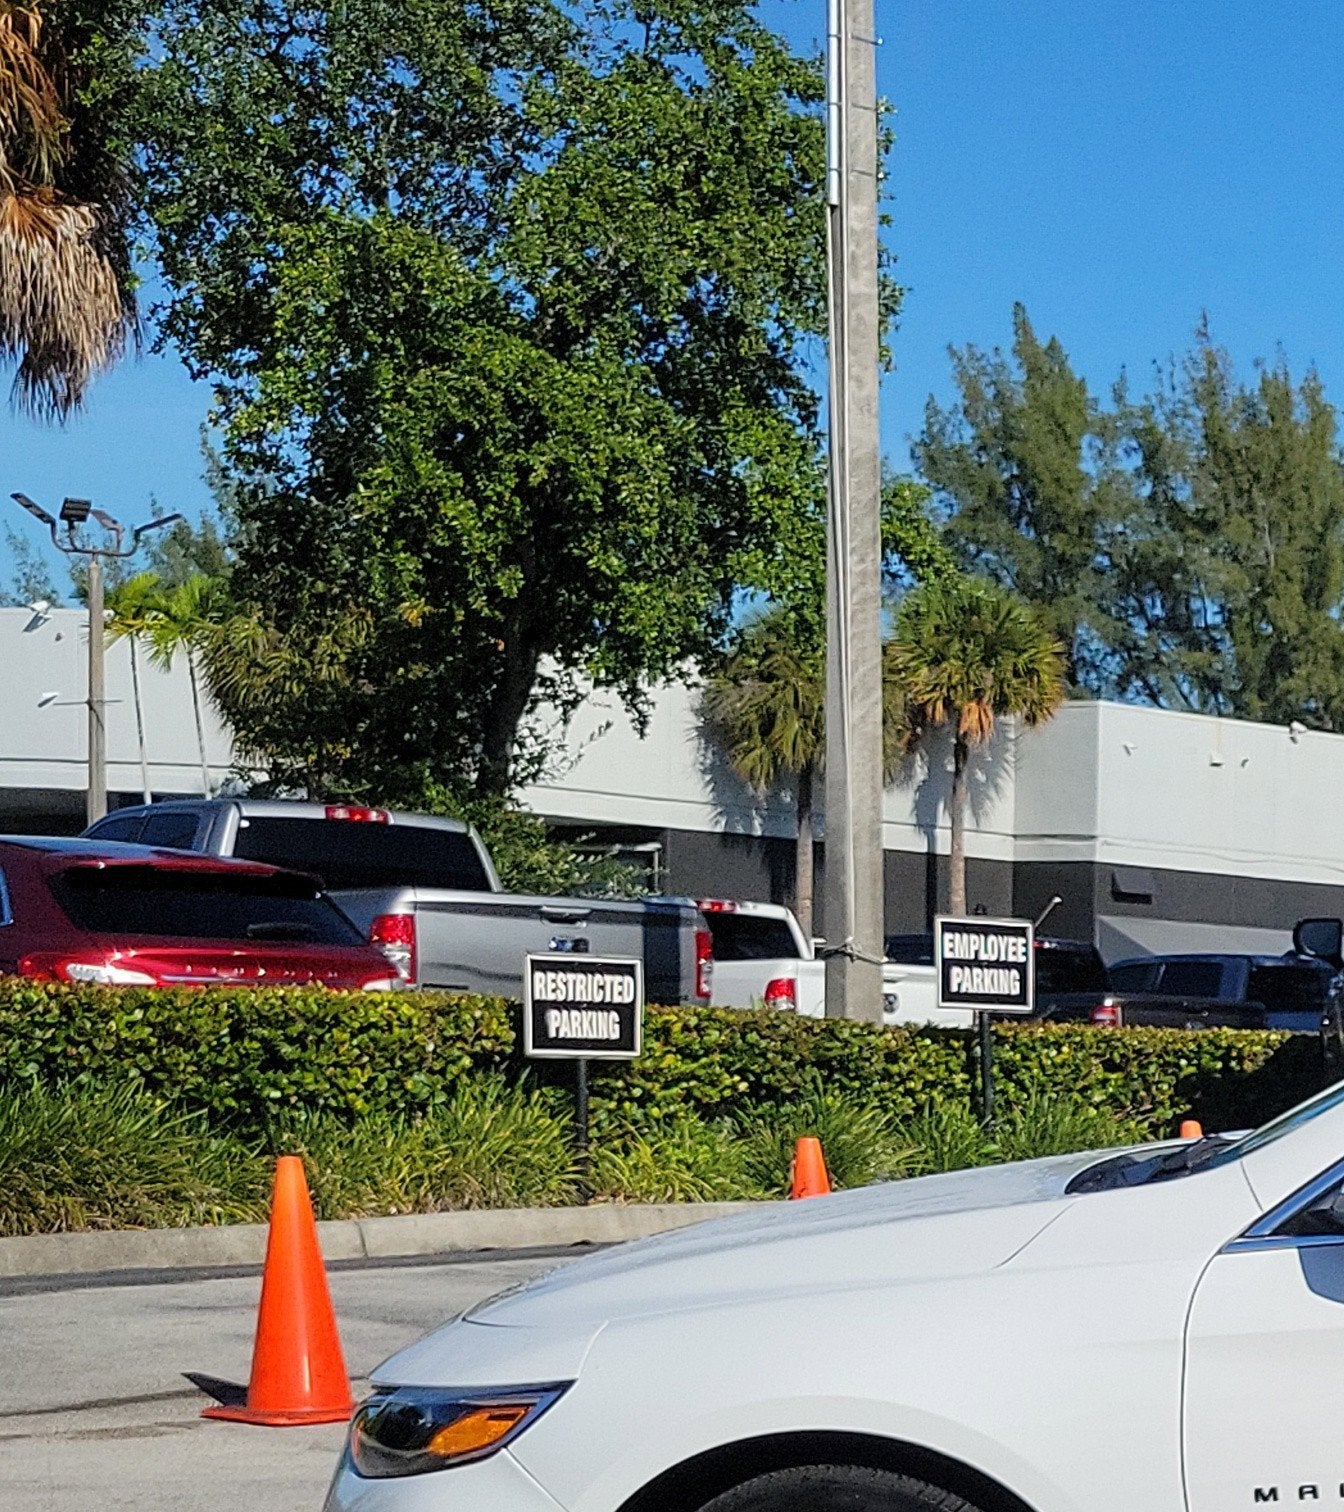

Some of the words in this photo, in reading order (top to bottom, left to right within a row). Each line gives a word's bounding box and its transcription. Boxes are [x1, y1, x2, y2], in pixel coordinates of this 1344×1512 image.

[942, 932, 1027, 963] EMPLOYEE
[533, 970, 634, 1004] RESTRICTED
[949, 965, 1020, 996] PARKING
[545, 1008, 620, 1040] PARKING
